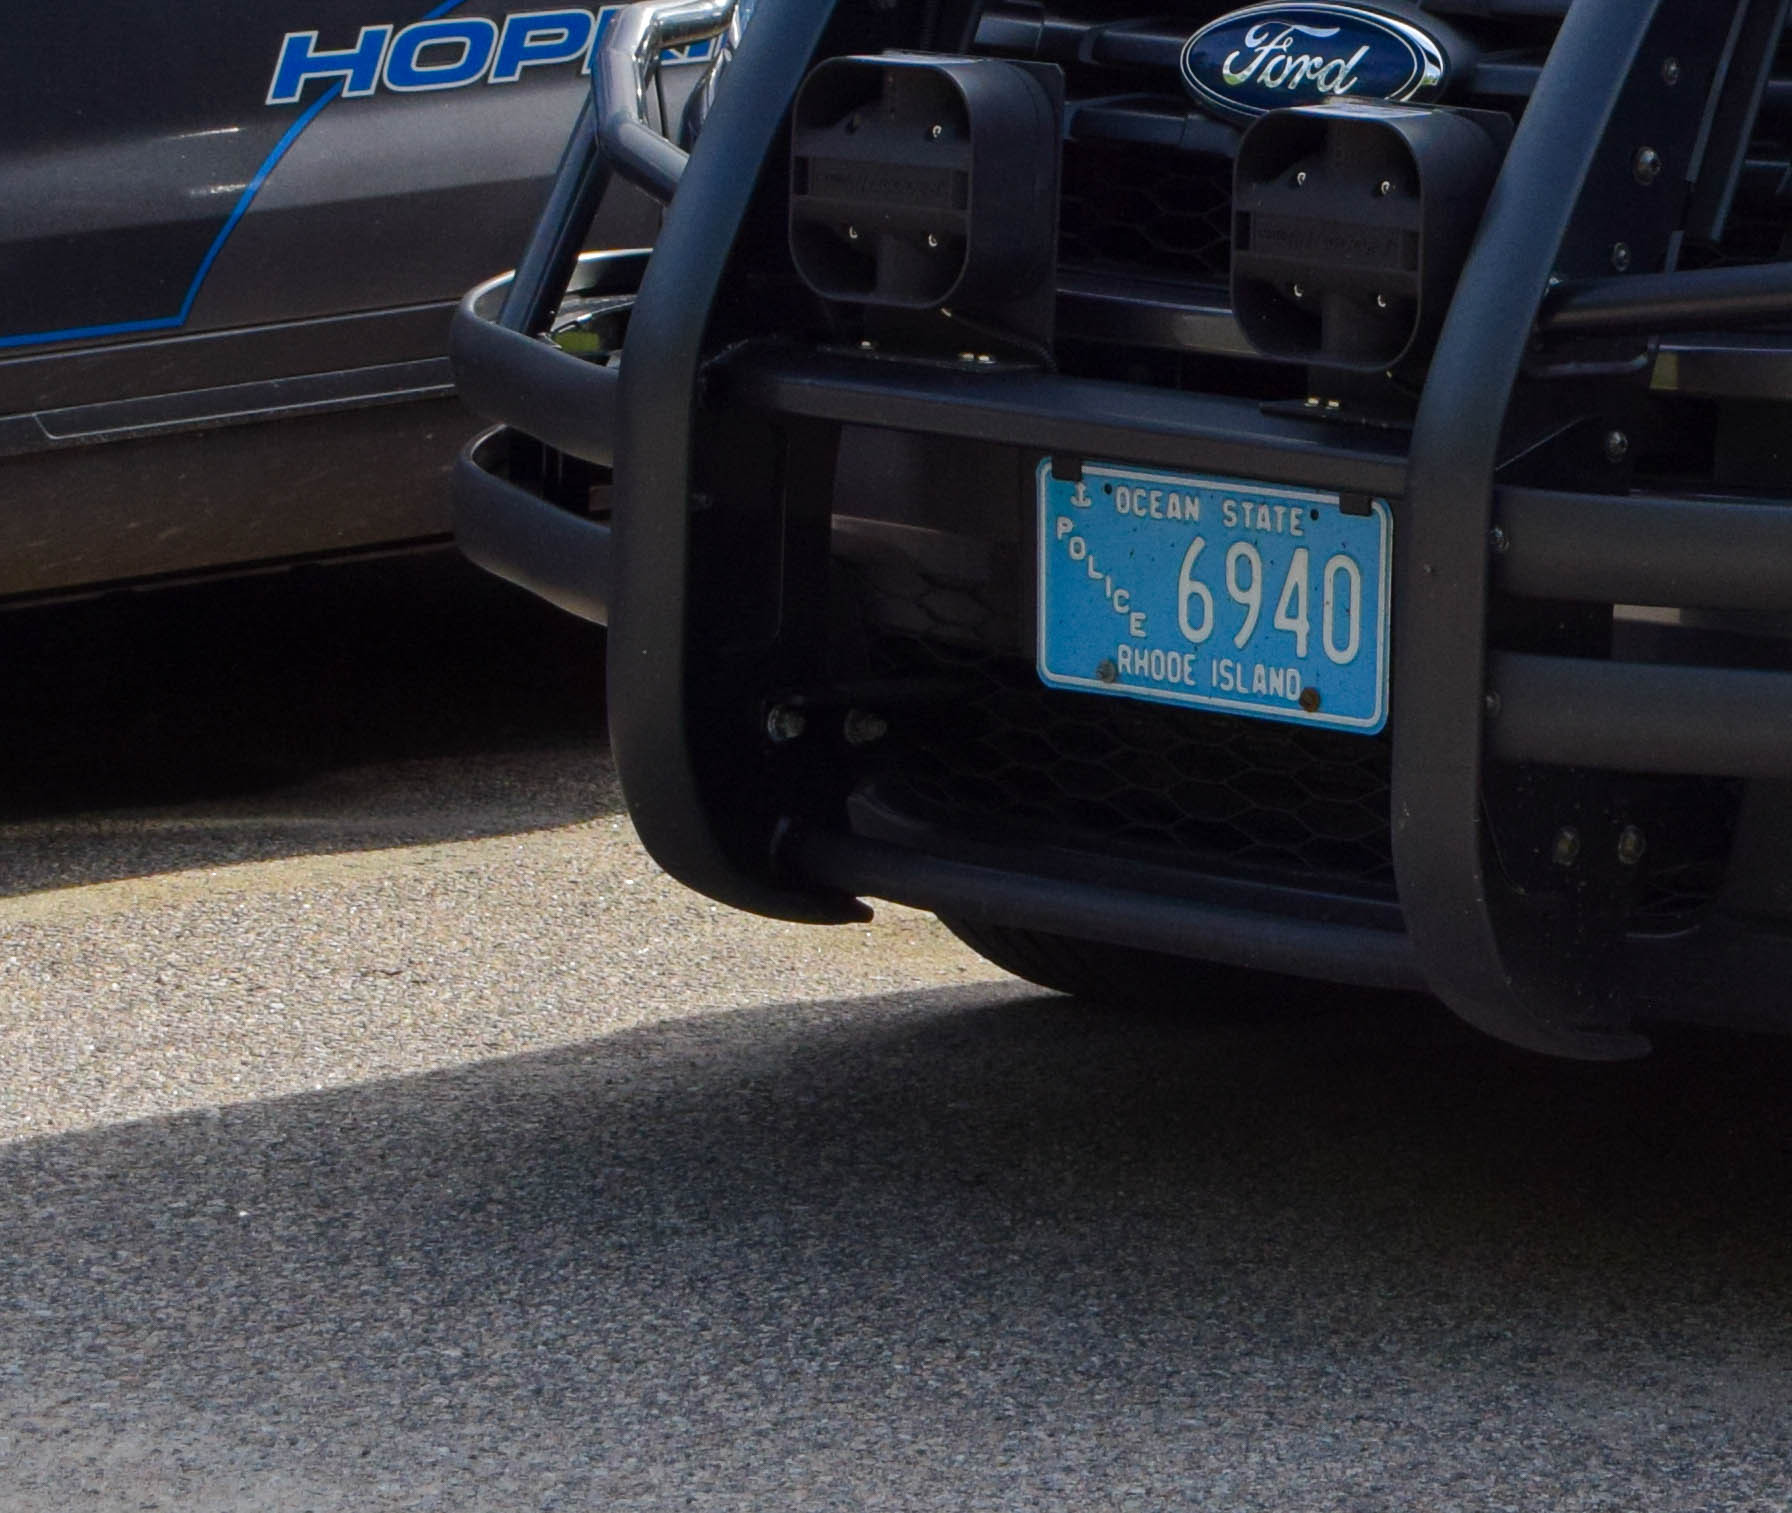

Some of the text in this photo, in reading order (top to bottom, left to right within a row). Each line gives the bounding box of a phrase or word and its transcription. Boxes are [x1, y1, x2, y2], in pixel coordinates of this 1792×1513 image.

[1222, 22, 1370, 93] Ford
[1115, 486, 1304, 536] OCEAN STATE
[1056, 516, 1147, 638] POLICE
[1178, 536, 1361, 665] 6940
[1117, 644, 1301, 701] RHODE ISLAND
